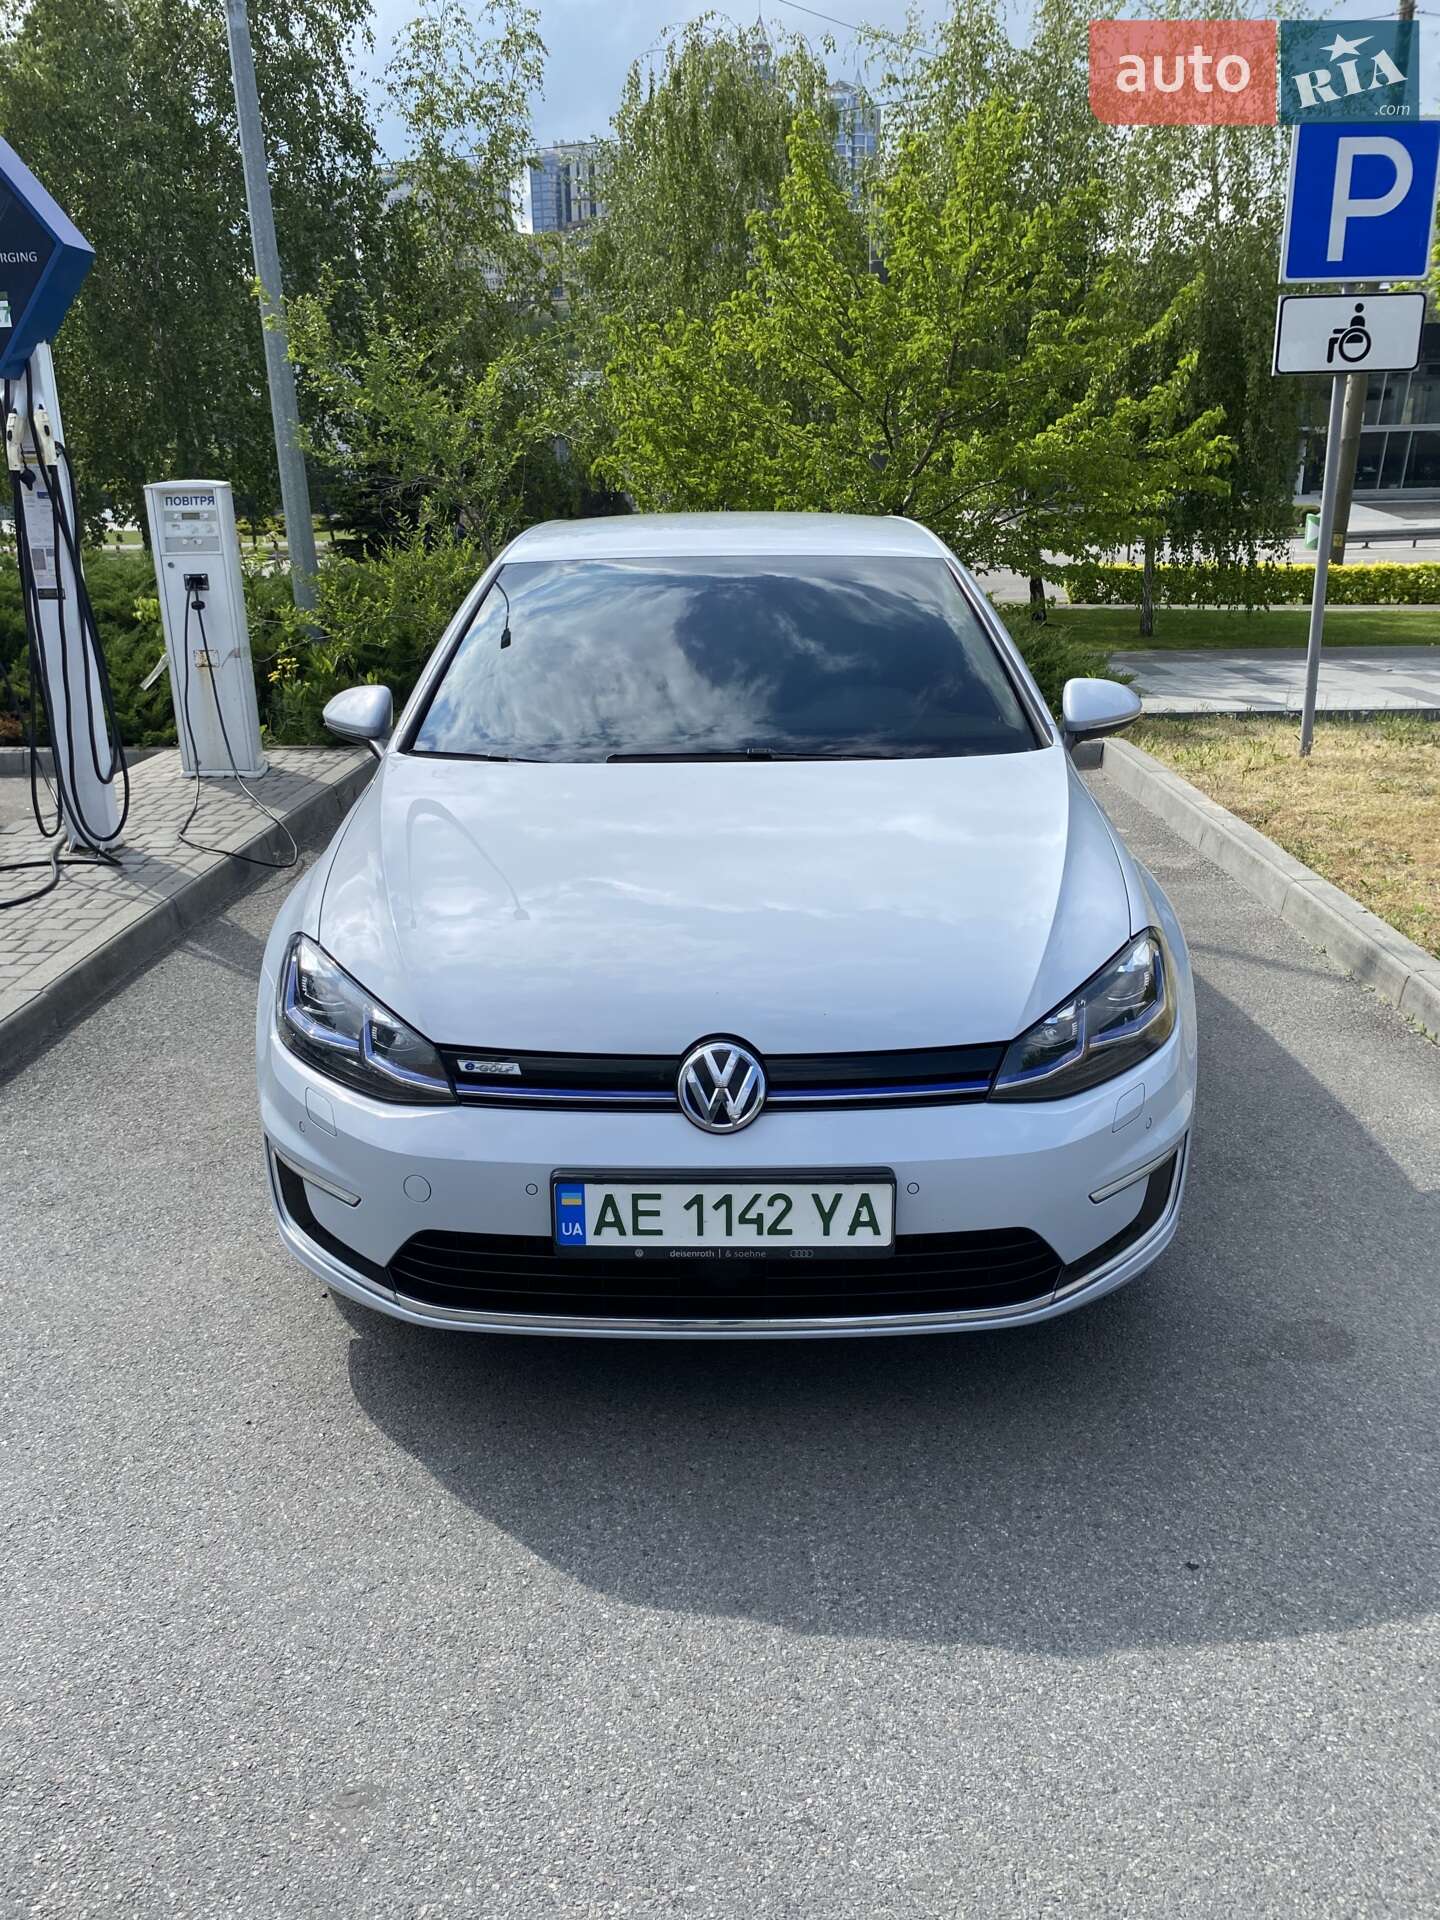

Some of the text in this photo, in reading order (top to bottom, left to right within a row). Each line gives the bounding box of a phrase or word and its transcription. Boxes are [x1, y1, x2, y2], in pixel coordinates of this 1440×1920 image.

[1326, 136, 1414, 262] P
[165, 495, 215, 506] ПОВІТРЯ
[561, 1222, 583, 1236] UA
[593, 1192, 882, 1237] AE 1142 YA
